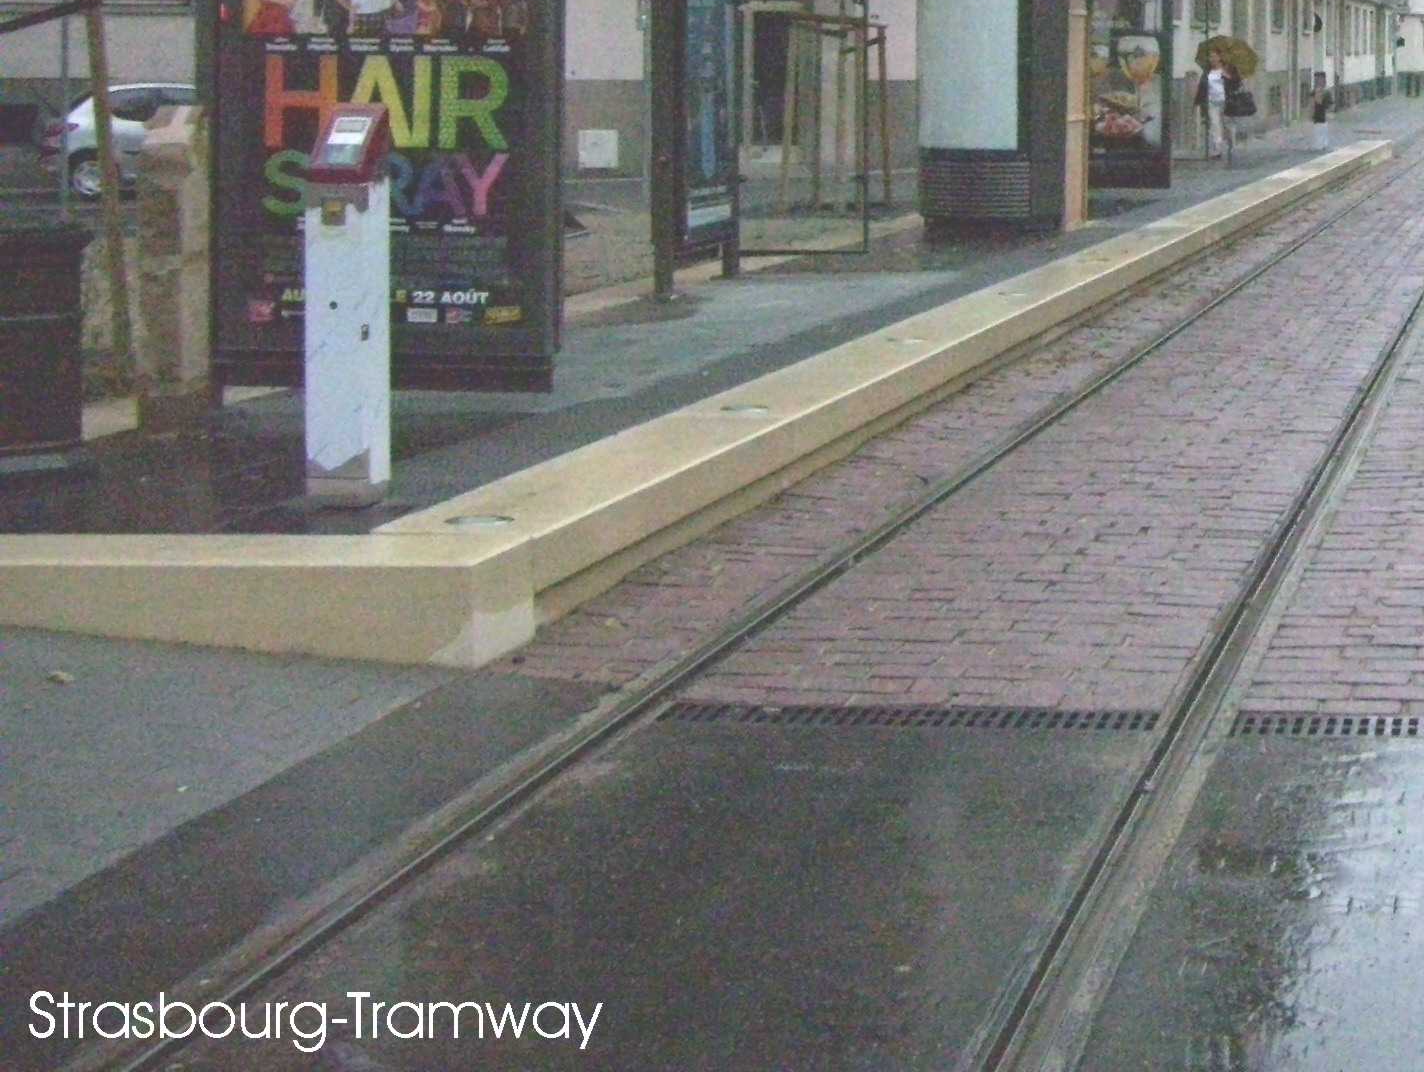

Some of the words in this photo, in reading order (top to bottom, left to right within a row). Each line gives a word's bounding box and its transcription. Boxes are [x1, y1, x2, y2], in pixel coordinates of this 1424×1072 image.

[264, 54, 509, 149] HAIR
[262, 149, 510, 216] SRAY
[412, 290, 435, 304] 22
